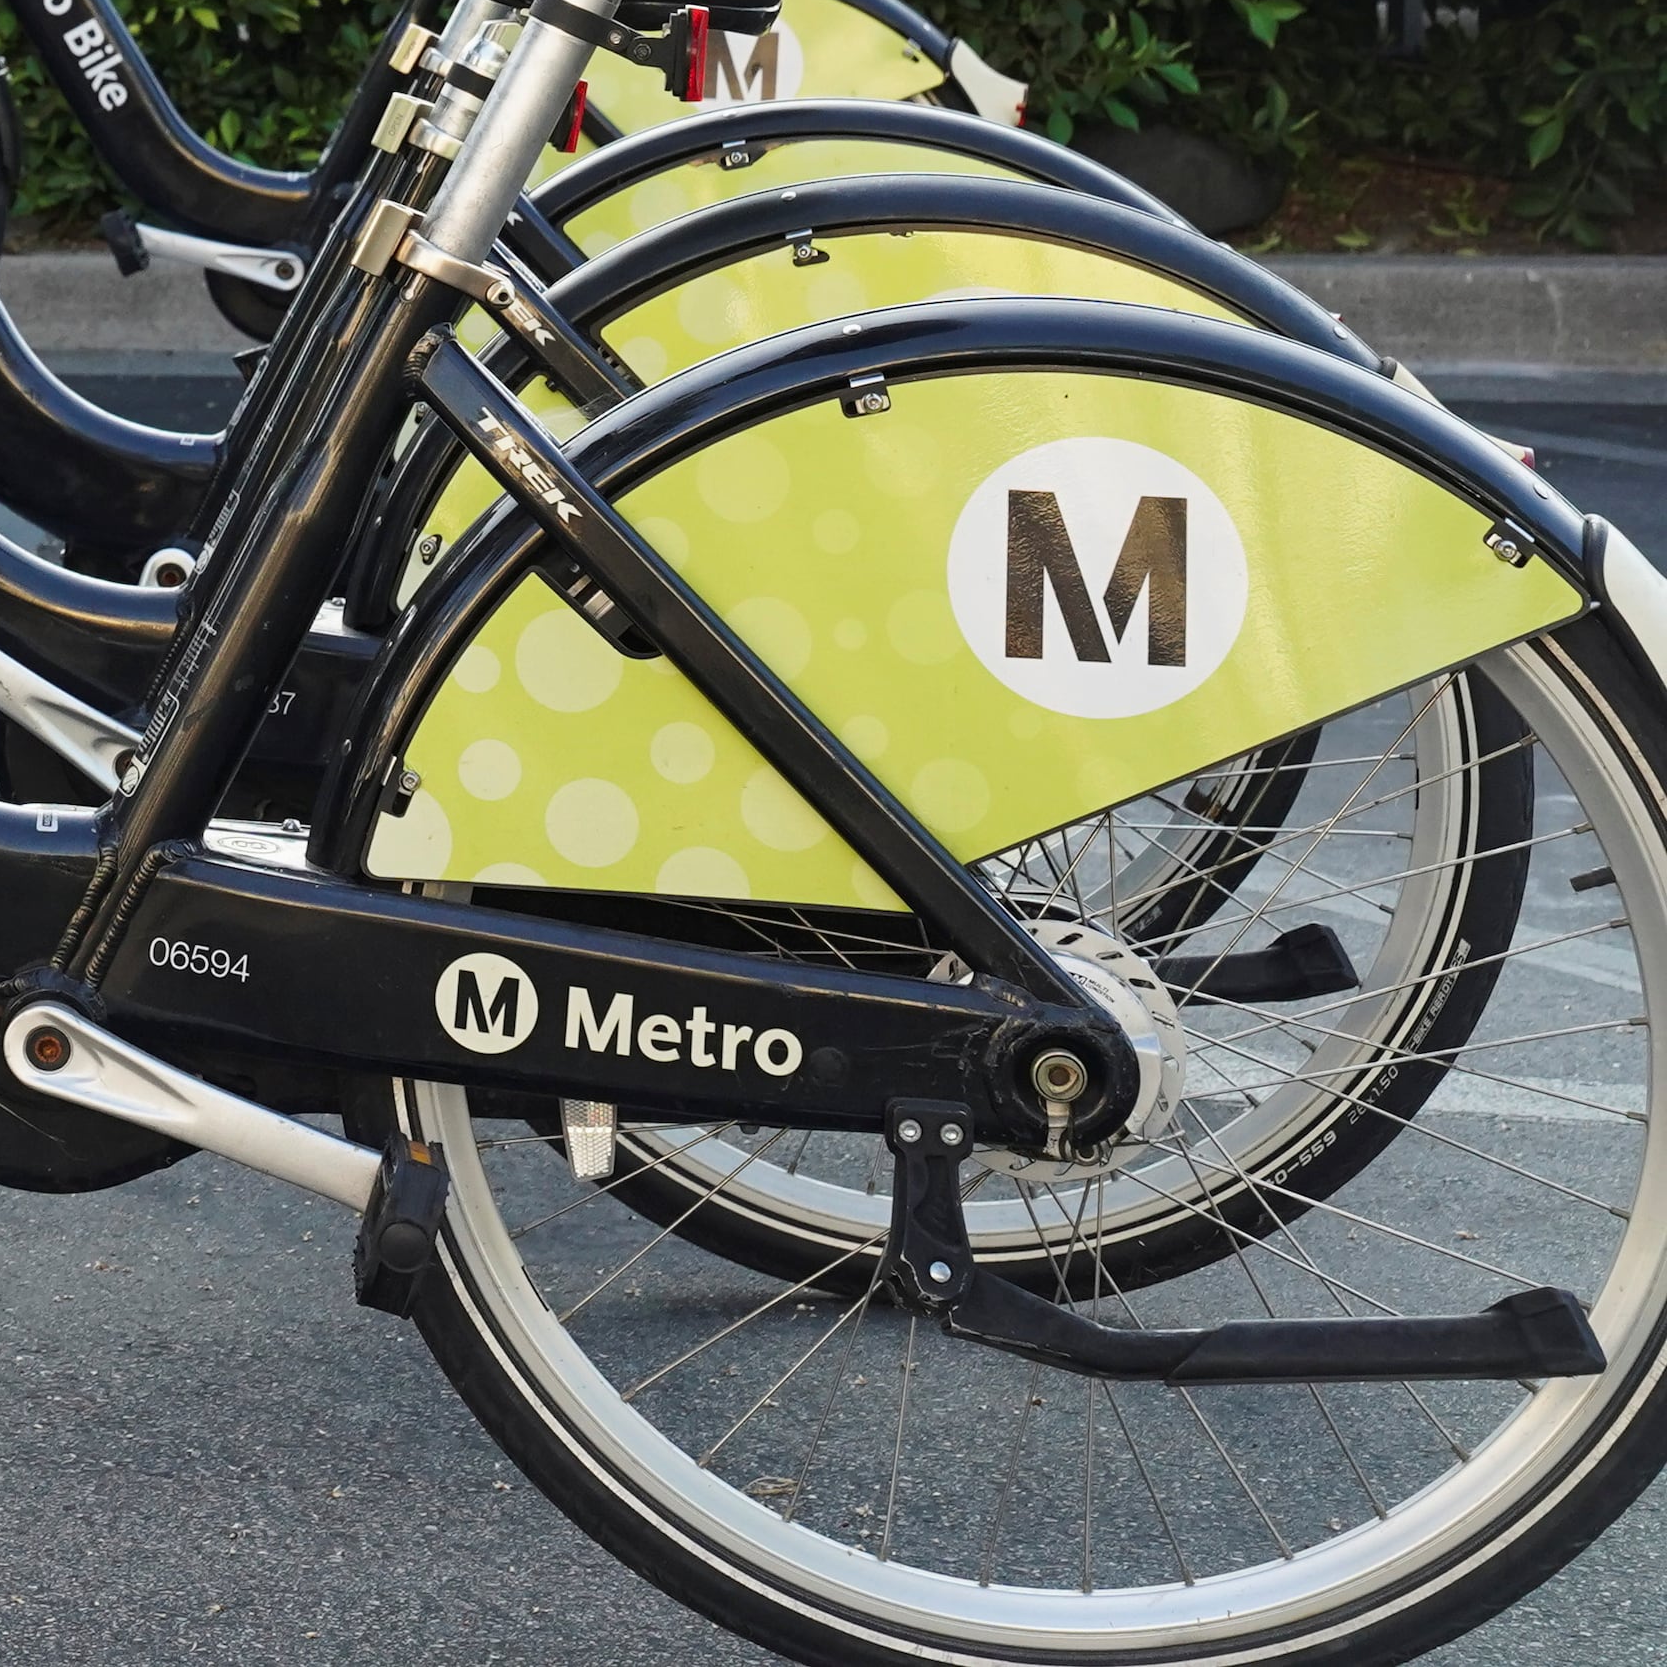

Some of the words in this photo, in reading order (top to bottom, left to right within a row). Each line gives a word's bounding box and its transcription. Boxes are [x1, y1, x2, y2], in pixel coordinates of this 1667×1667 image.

[62, 15, 131, 113] Bike
[509, 302, 557, 347] EK
[477, 406, 584, 524] TREK
[1005, 489, 1188, 667] M
[148, 936, 251, 984] 06594
[1089, 978, 1110, 993] MULTI
[453, 969, 522, 1037] M
[564, 984, 804, 1077] Metro
